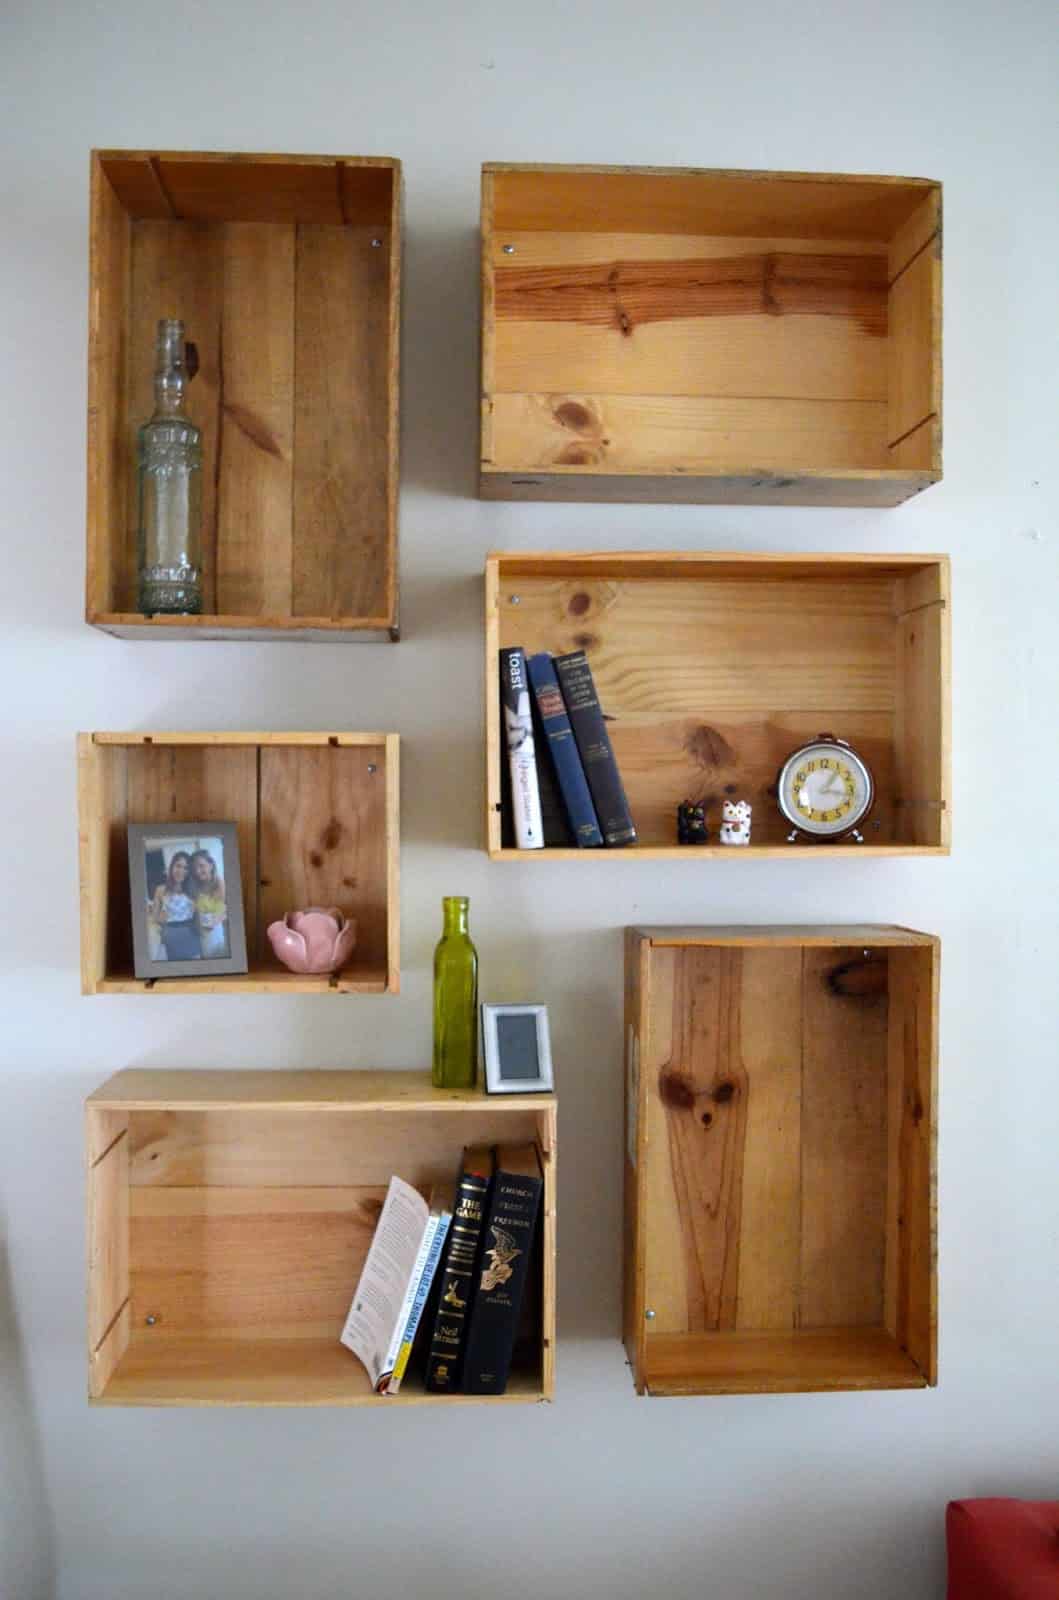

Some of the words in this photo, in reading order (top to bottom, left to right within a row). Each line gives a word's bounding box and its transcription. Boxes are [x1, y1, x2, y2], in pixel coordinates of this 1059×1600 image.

[508, 652, 524, 690] toast
[820, 759, 829, 769] 12
[461, 1198, 481, 1209] THE
[456, 1208, 482, 1221] GAME
